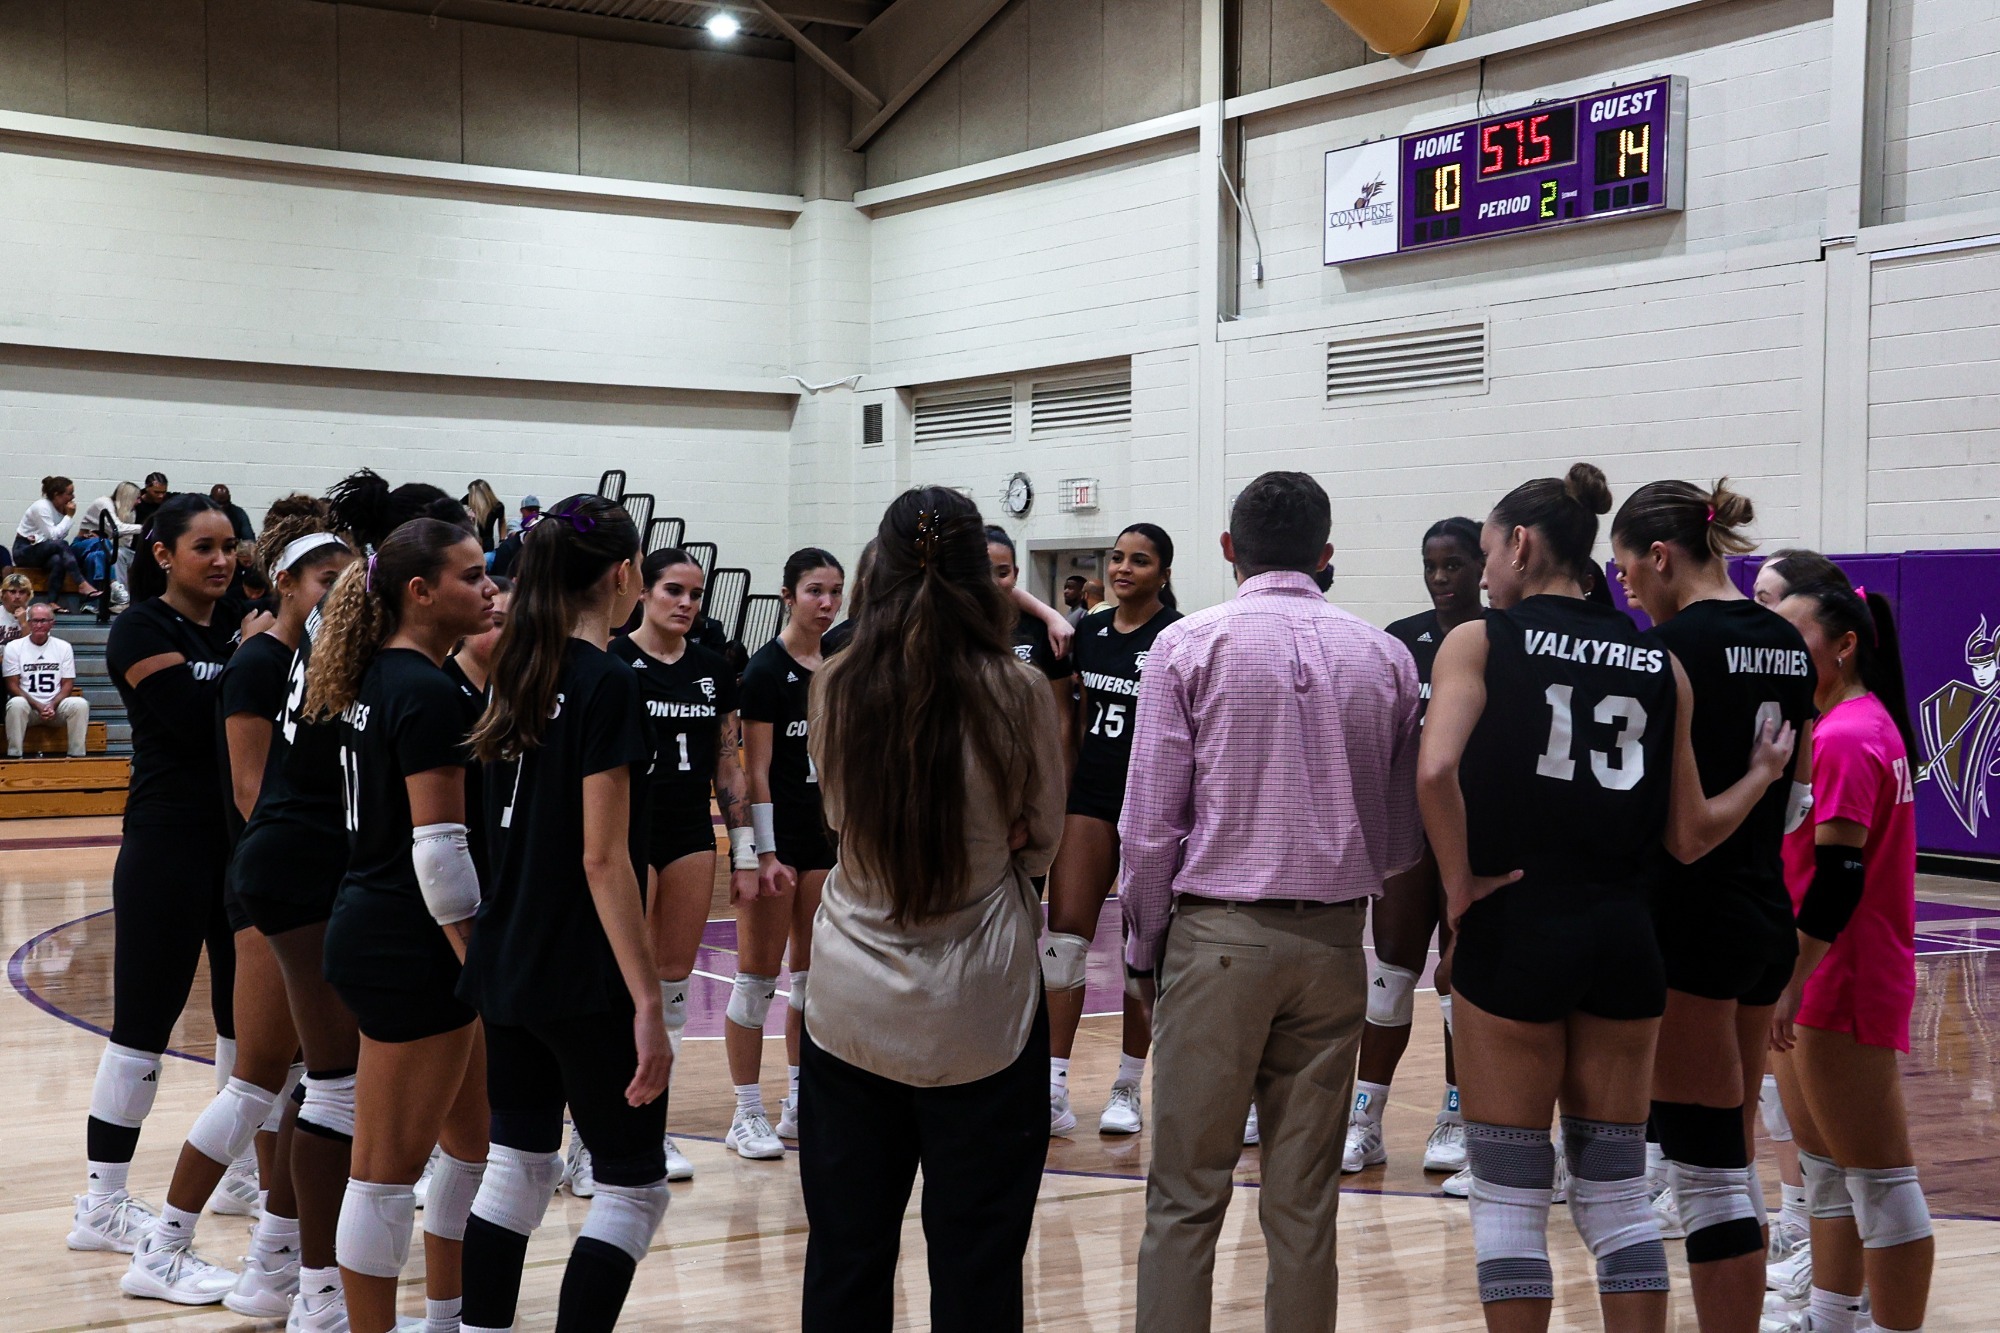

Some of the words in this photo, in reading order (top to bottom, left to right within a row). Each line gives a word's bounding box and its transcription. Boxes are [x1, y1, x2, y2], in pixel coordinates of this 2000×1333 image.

[1589, 88, 1658, 123] GUEST
[1413, 131, 1465, 161] HOME
[1617, 124, 1650, 178] 14
[1433, 163, 1462, 213] 10
[1540, 180, 1557, 218] 2
[1330, 203, 1392, 228] CONVERSE
[1477, 194, 1531, 220] PERIOD
[1523, 628, 1665, 674] VALKYRIES
[1725, 646, 1809, 677] VALKYRIES
[28, 674, 55, 693] 15
[1090, 702, 1127, 738] 15
[1535, 683, 1648, 792] 13
[675, 733, 692, 771] 1
